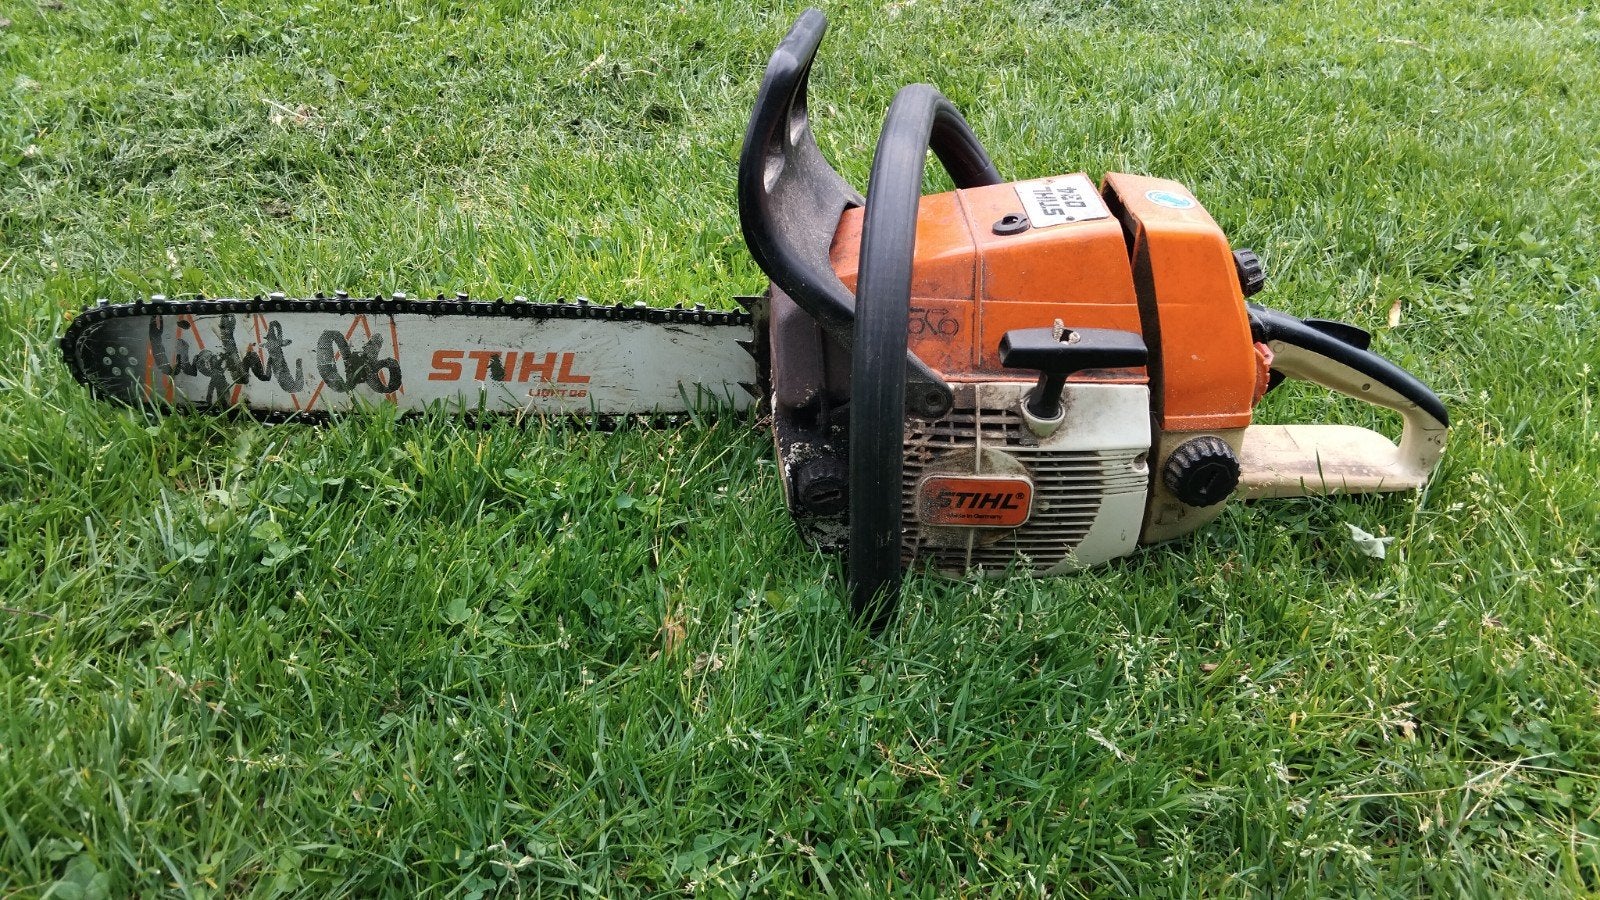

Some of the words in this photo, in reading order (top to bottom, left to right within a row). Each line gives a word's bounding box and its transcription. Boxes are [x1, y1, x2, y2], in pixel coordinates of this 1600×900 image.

[1033, 186, 1065, 216] STIHL
[1057, 186, 1087, 208] 034
[428, 349, 591, 383] STIHL
